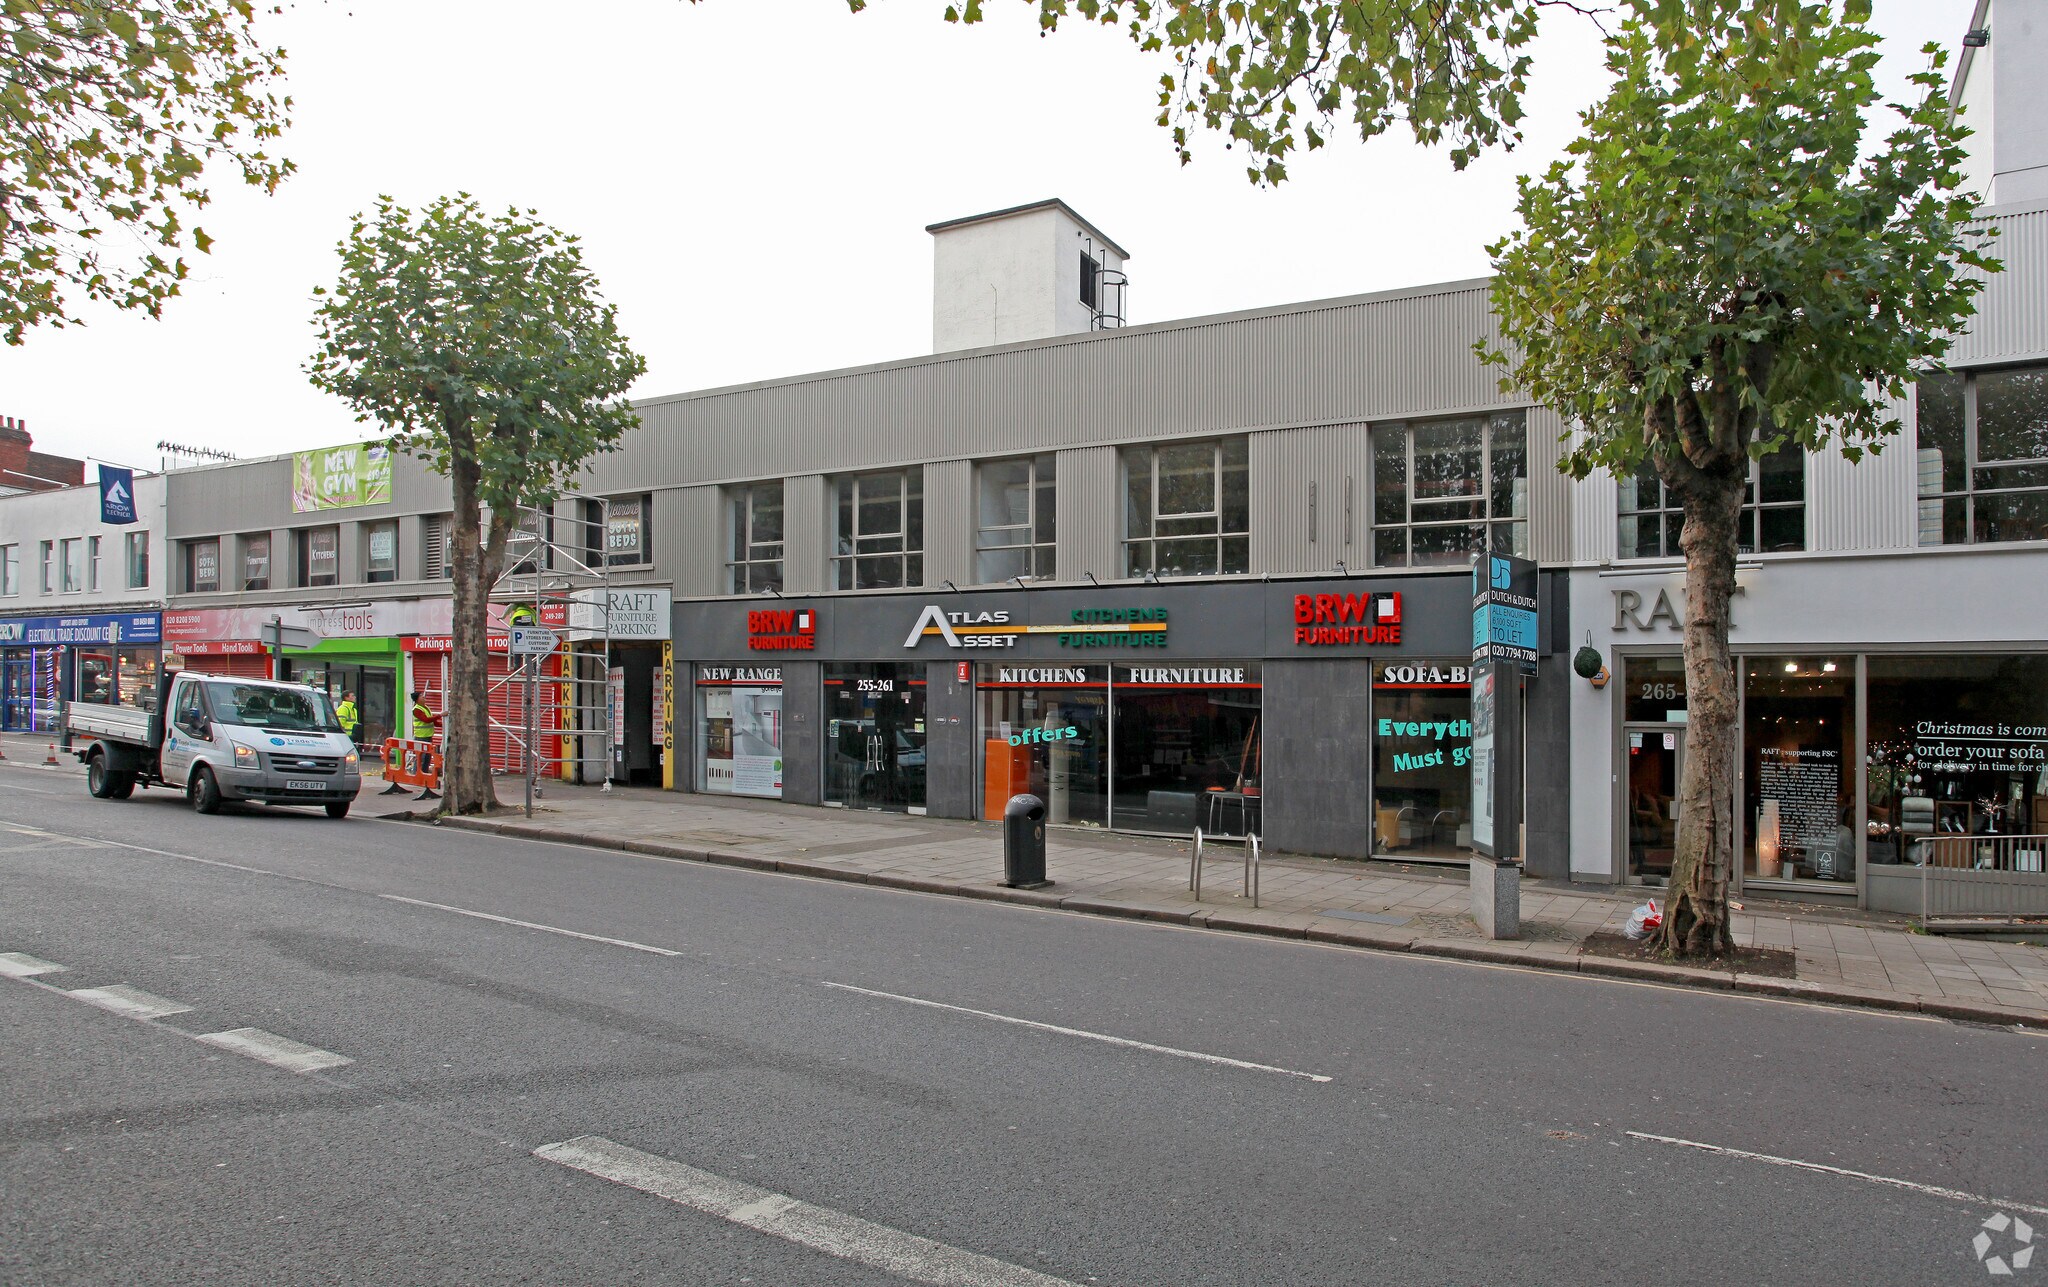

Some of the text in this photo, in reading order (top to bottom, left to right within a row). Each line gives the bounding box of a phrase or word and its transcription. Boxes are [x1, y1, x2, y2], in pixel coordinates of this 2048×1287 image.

[324, 449, 357, 474] NEW
[323, 471, 356, 495] GYM
[609, 533, 636, 548] BEDS
[199, 557, 215, 567] SOFA
[199, 568, 215, 578] BEDS
[607, 593, 658, 611] RAFT
[1491, 590, 1537, 609] DUTCH & DUTCH
[1071, 608, 1168, 622] KITCHENS
[1294, 592, 1371, 624] BRW
[1492, 606, 1502, 616] ALL
[1503, 608, 1531, 621] ENQUIRIES
[1611, 586, 1746, 631] RA
[166, 616, 175, 624] 020
[188, 615, 201, 623] 5900
[343, 609, 373, 631] tools
[607, 613, 658, 622] FURNITURE
[747, 609, 796, 634] BRW
[28, 625, 123, 643] ELECTRICAL TRADE DISCOUNT CEE
[607, 624, 657, 635] PARKING
[1294, 625, 1402, 644] FURNITURE
[1492, 626, 1523, 644] TO LET
[415, 637, 445, 651] Parking
[494, 639, 509, 648] roo
[514, 631, 523, 644] P
[747, 635, 816, 650] FURNITURE
[1058, 632, 1168, 648] FURNITURE
[175, 643, 208, 653] Power Tools
[221, 642, 254, 653] Hand Tools
[1491, 644, 1537, 662] 020 7794 7788
[702, 667, 782, 680] NEW RANGE
[999, 668, 1086, 683] KITCHENS
[1129, 668, 1244, 683] FURNITURE
[857, 679, 894, 691] 255-261
[1642, 683, 1688, 700] 265-
[664, 642, 673, 750] PARKING
[1007, 725, 1078, 747] offers
[1916, 721, 1994, 735] Christmas
[1997, 722, 2011, 736] is
[1761, 747, 1781, 755] RAFT
[1785, 749, 1821, 758] supporting
[1917, 741, 2046, 761] order your sofa
[1392, 748, 1444, 773] Must
[1917, 759, 1932, 769] for
[1937, 760, 1977, 773] delivery
[1979, 761, 1987, 771] in
[1991, 761, 2016, 772] time
[2018, 762, 2034, 772] for
